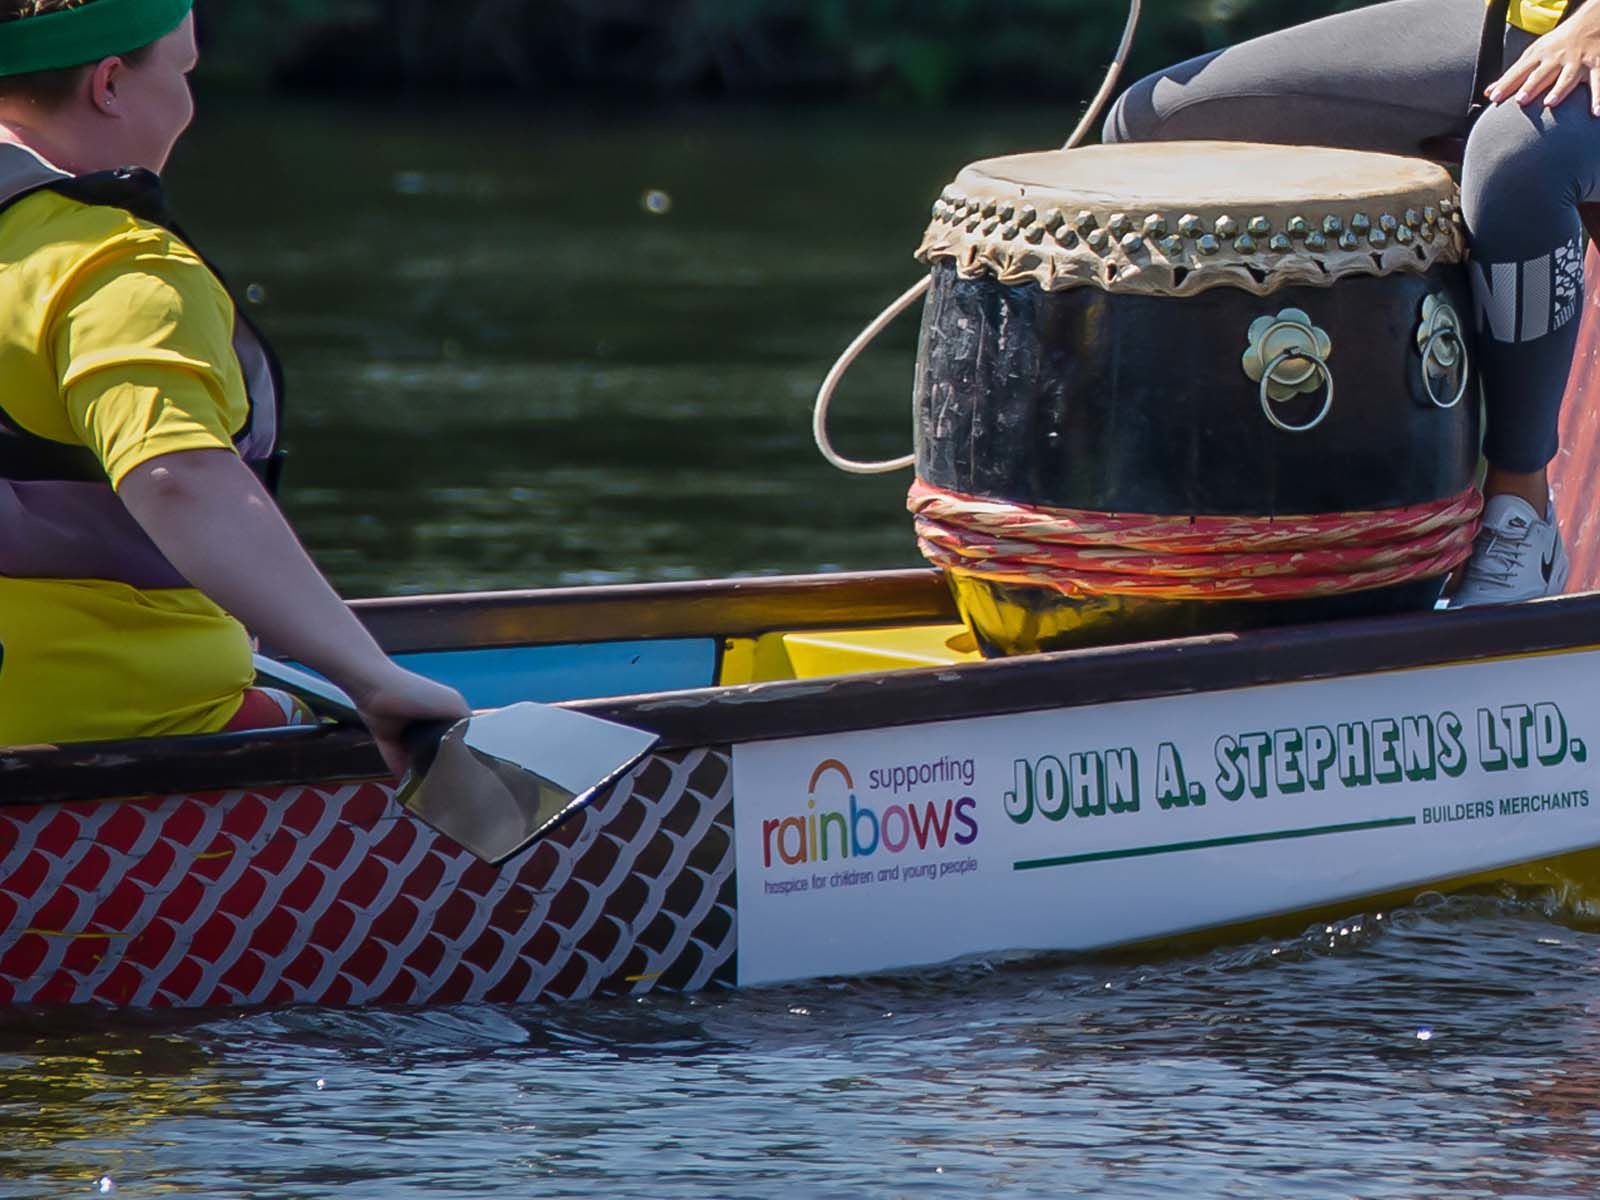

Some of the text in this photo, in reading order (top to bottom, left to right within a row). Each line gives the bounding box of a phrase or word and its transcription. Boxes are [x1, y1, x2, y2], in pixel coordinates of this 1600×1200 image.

[869, 756, 975, 794] supporting
[1003, 702, 1587, 824] JOHN A. STEPHENS LTD.
[1422, 789, 1590, 825] BUILDERS MERCHANTS
[762, 794, 979, 868] rainbows
[764, 857, 978, 896] hospice for children and young people
